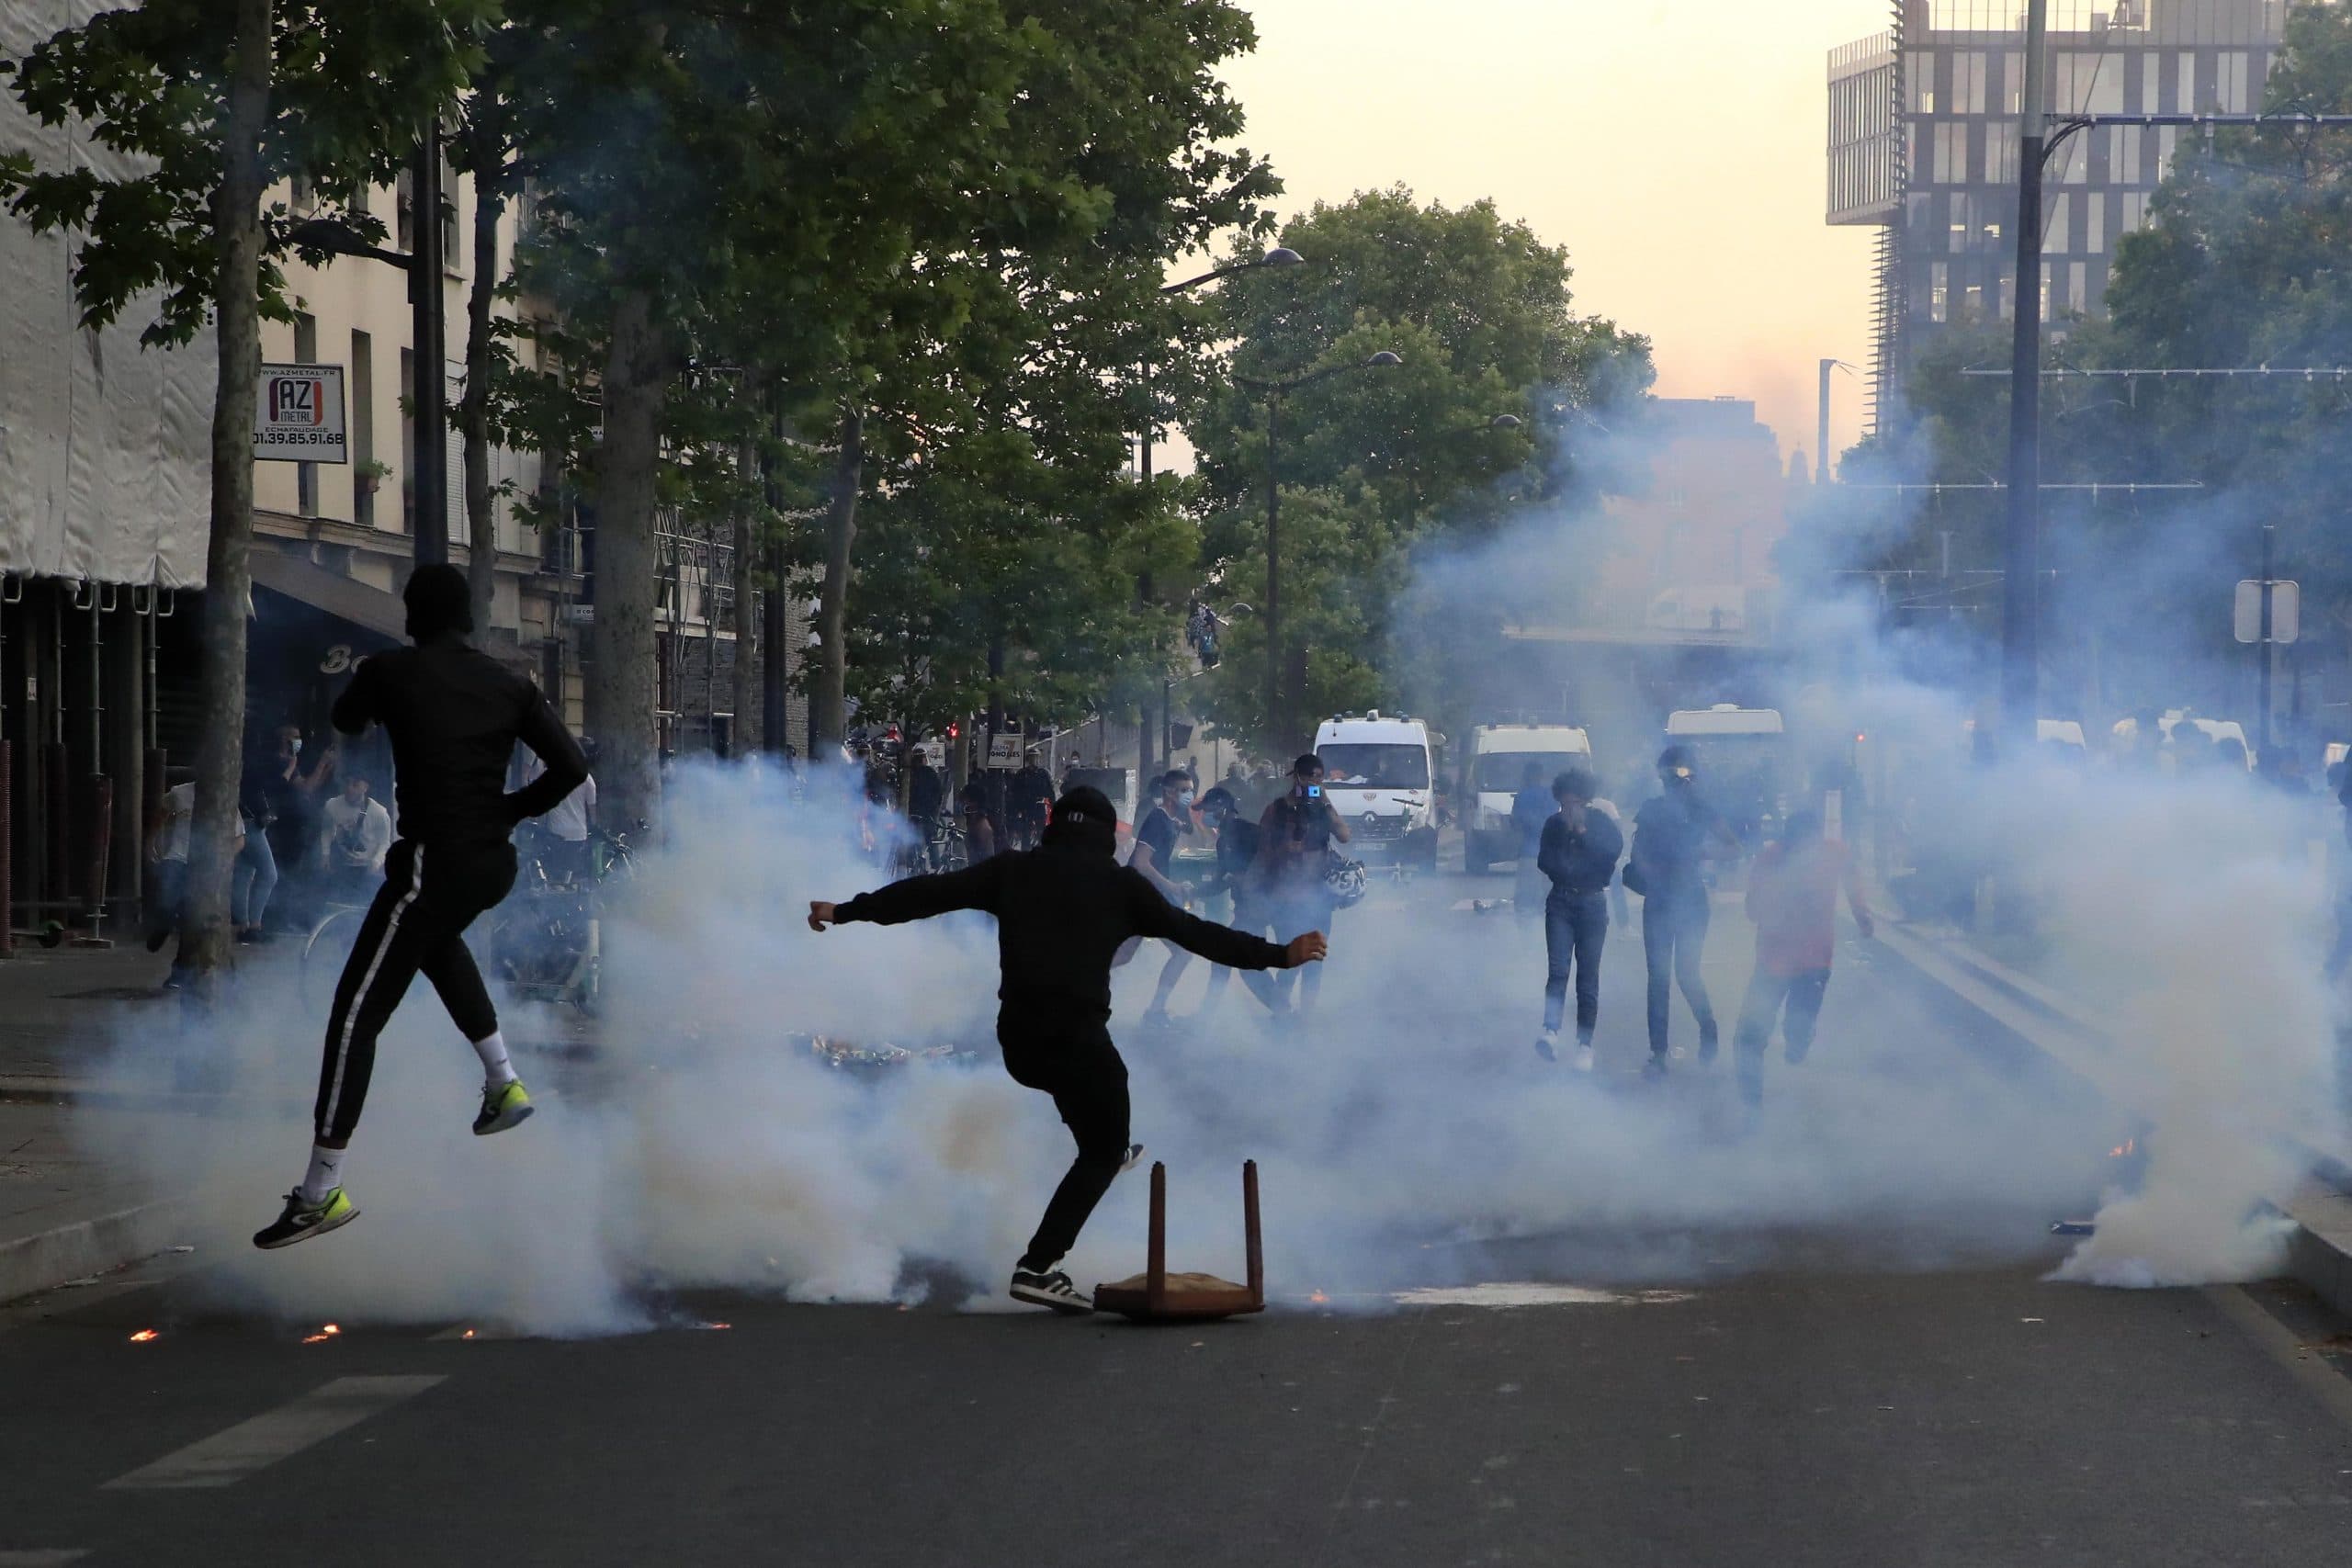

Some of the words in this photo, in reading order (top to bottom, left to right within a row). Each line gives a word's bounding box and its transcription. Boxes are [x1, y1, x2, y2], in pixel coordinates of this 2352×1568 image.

[279, 379, 312, 410] AZ
[280, 411, 312, 423] METAL
[253, 433, 344, 445] 01.39.85.91.68
